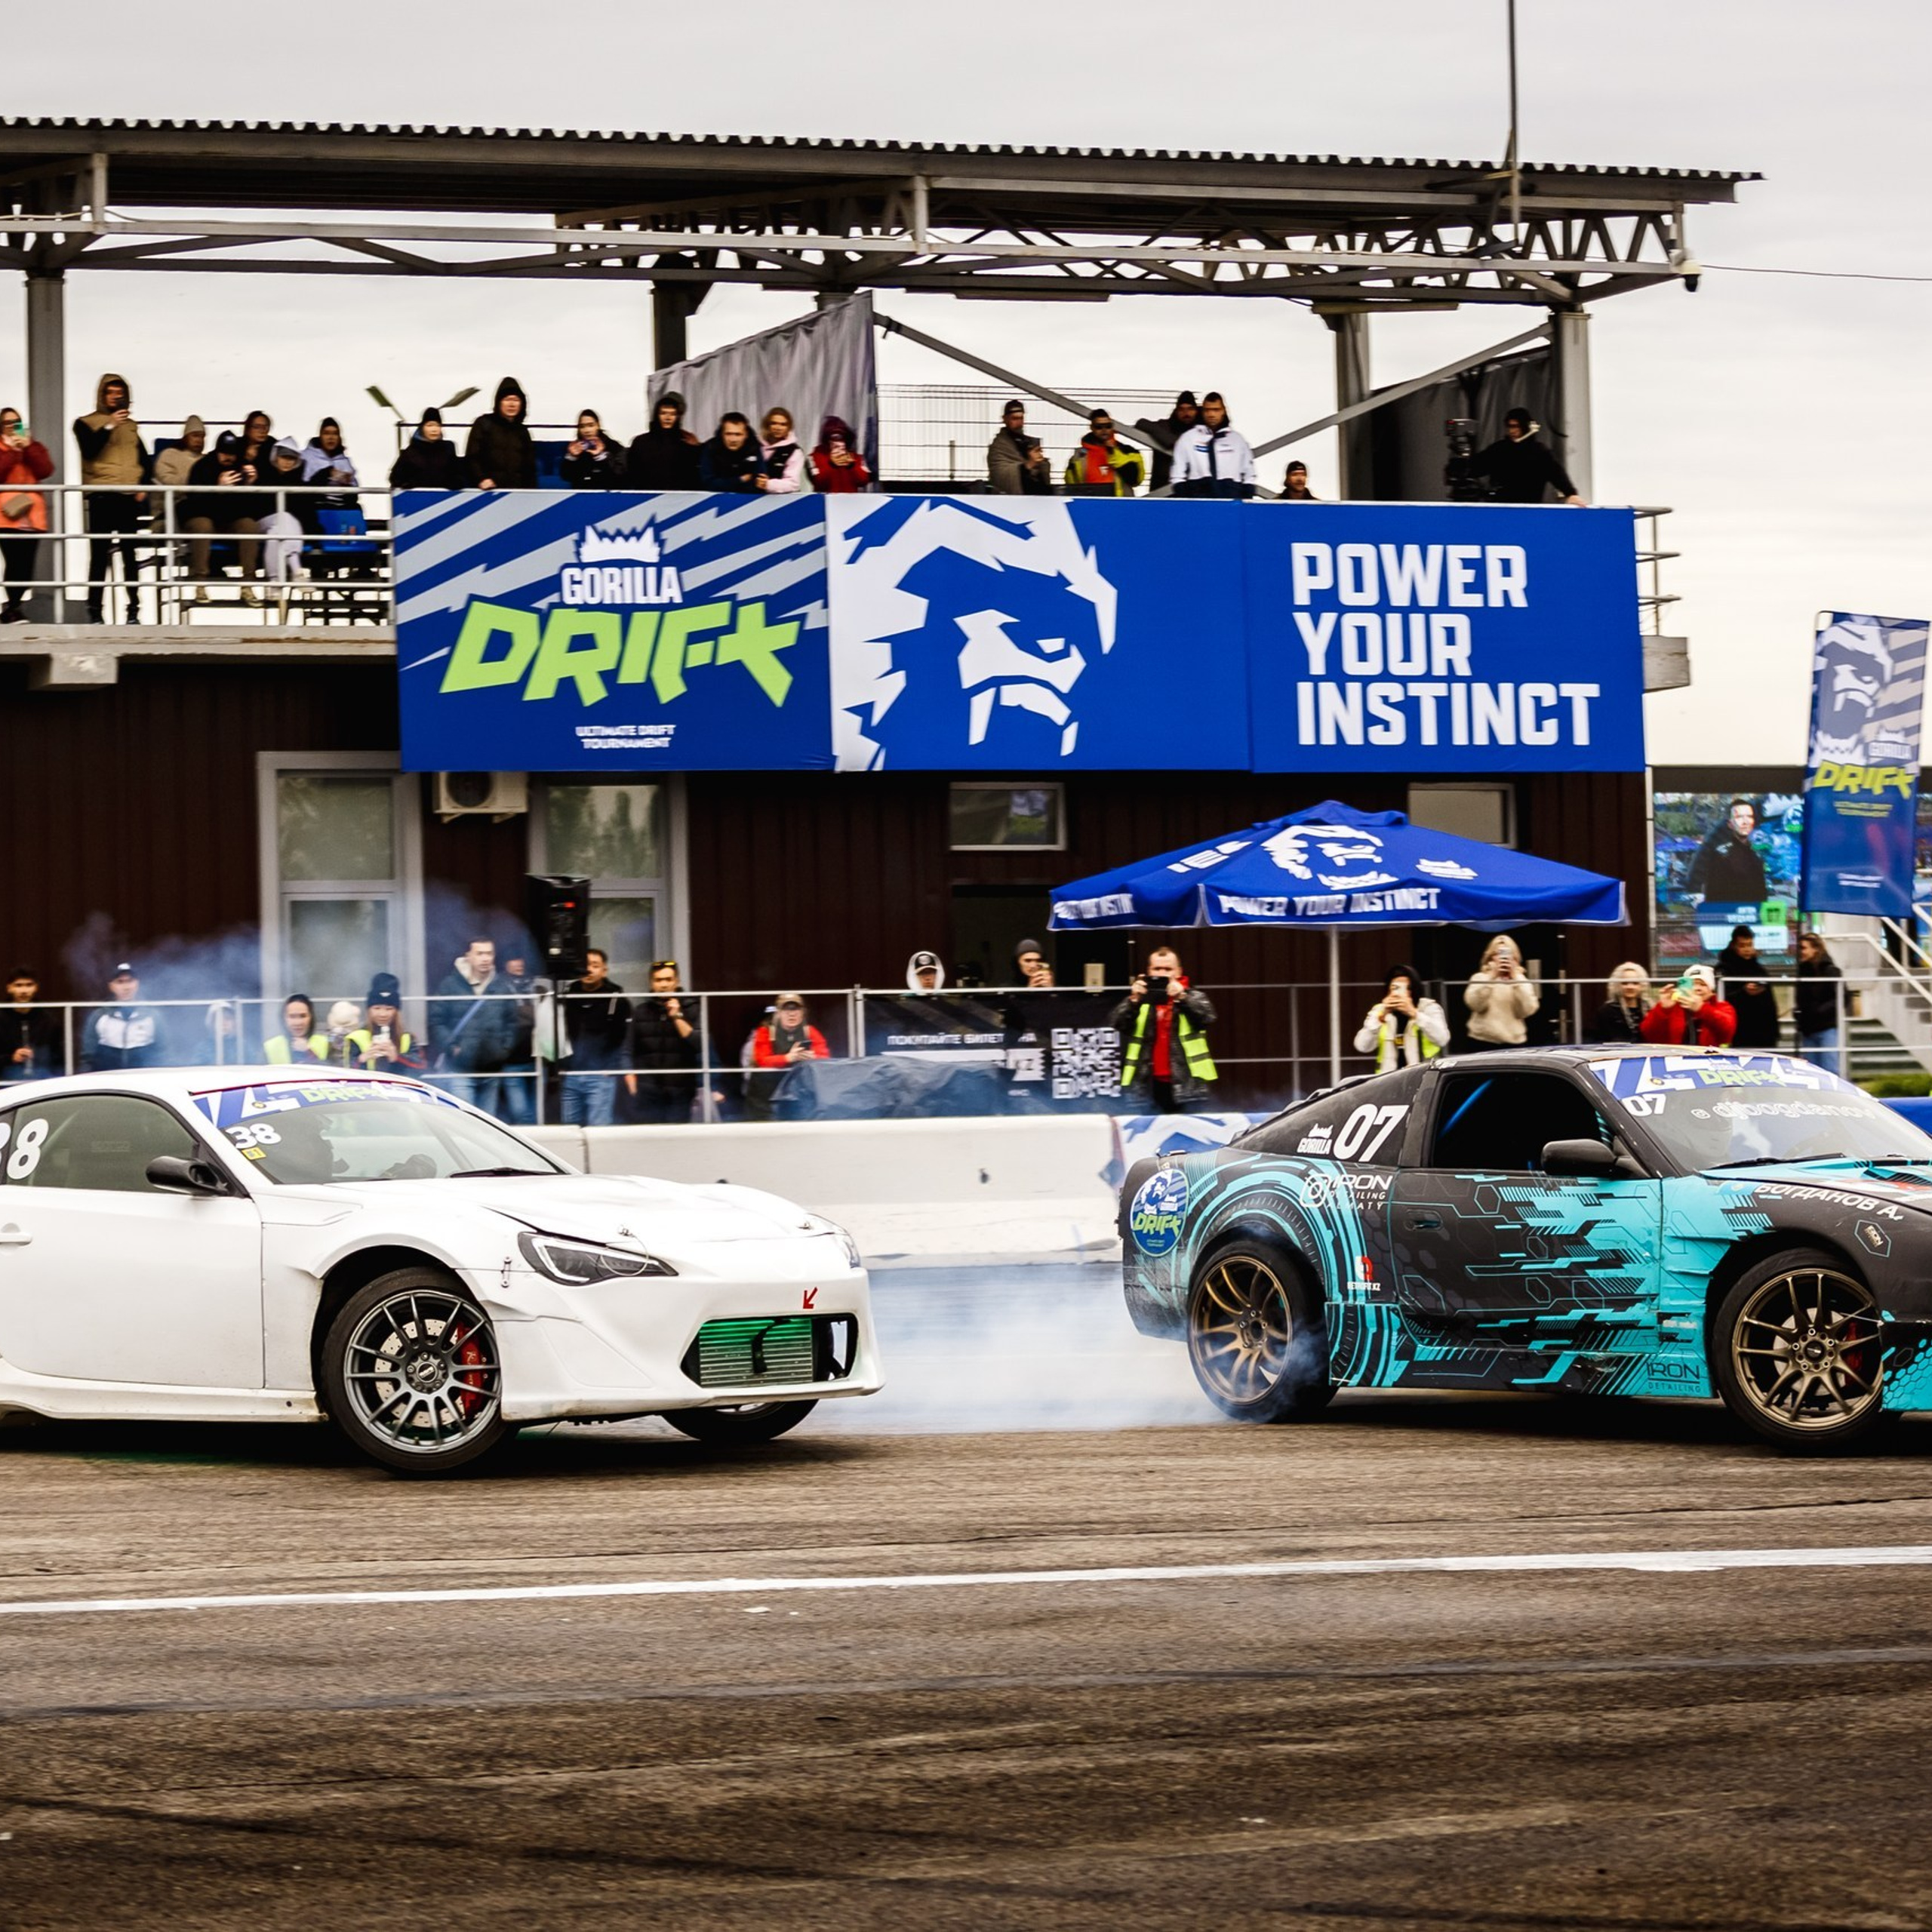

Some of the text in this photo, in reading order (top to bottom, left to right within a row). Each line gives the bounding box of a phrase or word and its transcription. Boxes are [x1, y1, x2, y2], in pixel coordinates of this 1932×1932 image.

[561, 566, 682, 604] GORILLA
[1291, 542, 1527, 608] POWER
[439, 601, 800, 707] DRIFT
[1292, 612, 1472, 675] YOUR
[1297, 681, 1600, 746] INSTINCT
[575, 724, 676, 736] ULTIMATE DRIFT
[581, 737, 672, 749] TOURNAMENT
[1814, 761, 1915, 799] DRIFT
[1217, 888, 1441, 916] POWER YOUR INSTINCT
[1697, 1069, 1787, 1087] DRIFT
[1623, 1094, 1666, 1116] 07
[226, 1123, 281, 1149] 38
[1333, 1103, 1410, 1162] 07
[0, 1118, 49, 1180] 8
[1297, 1137, 1333, 1155] GORILLA
[1331, 1190, 1386, 1200] DAILING
[1333, 1174, 1393, 1190] IRON
[1755, 1185, 1880, 1211] БОГДАНОВ
[1133, 1212, 1182, 1238] DRIFT
[1646, 1361, 1700, 1380] IRON
[1648, 1382, 1701, 1392] DETAILING
